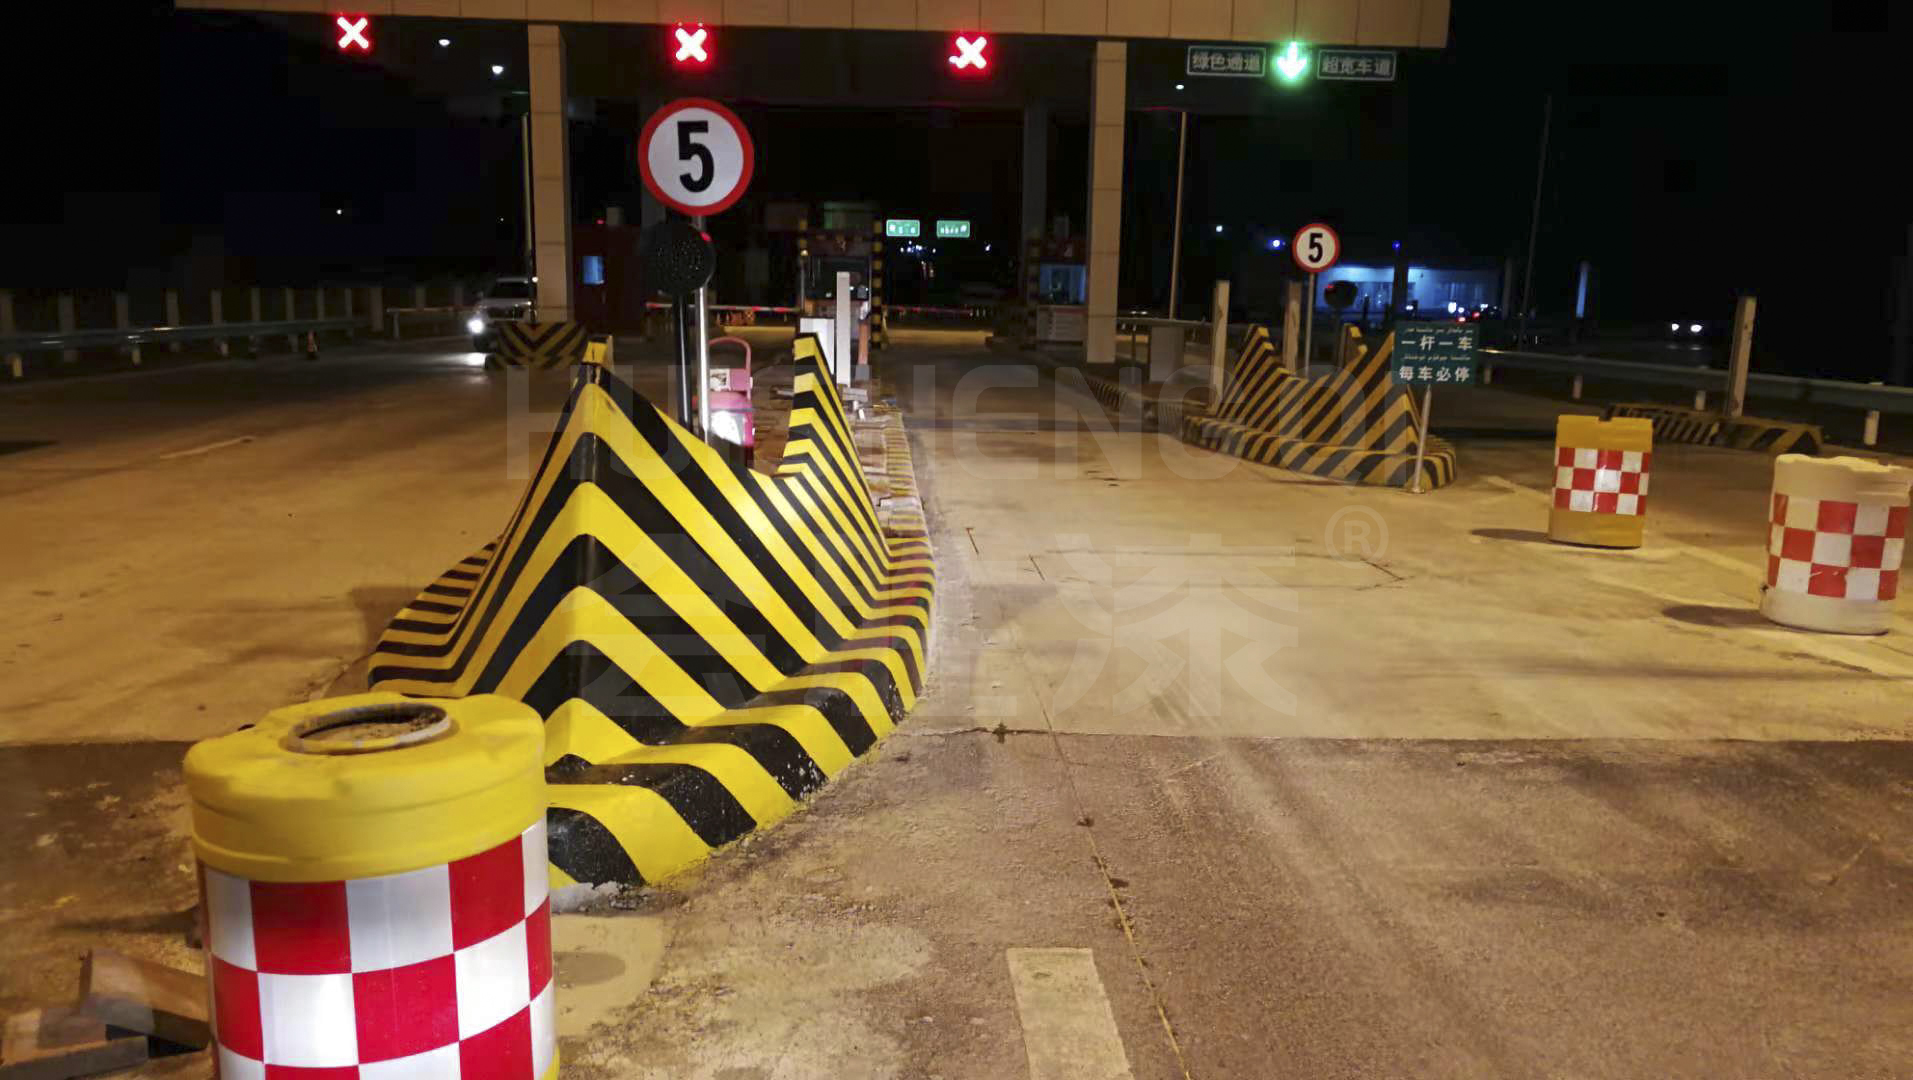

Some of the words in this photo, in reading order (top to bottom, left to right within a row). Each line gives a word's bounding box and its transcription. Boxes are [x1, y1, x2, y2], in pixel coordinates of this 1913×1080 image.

[677, 120, 715, 193] 5
[1308, 233, 1324, 263] 5
[1400, 335, 1473, 351] 一杆一车
[1399, 366, 1470, 382] 每车必停
